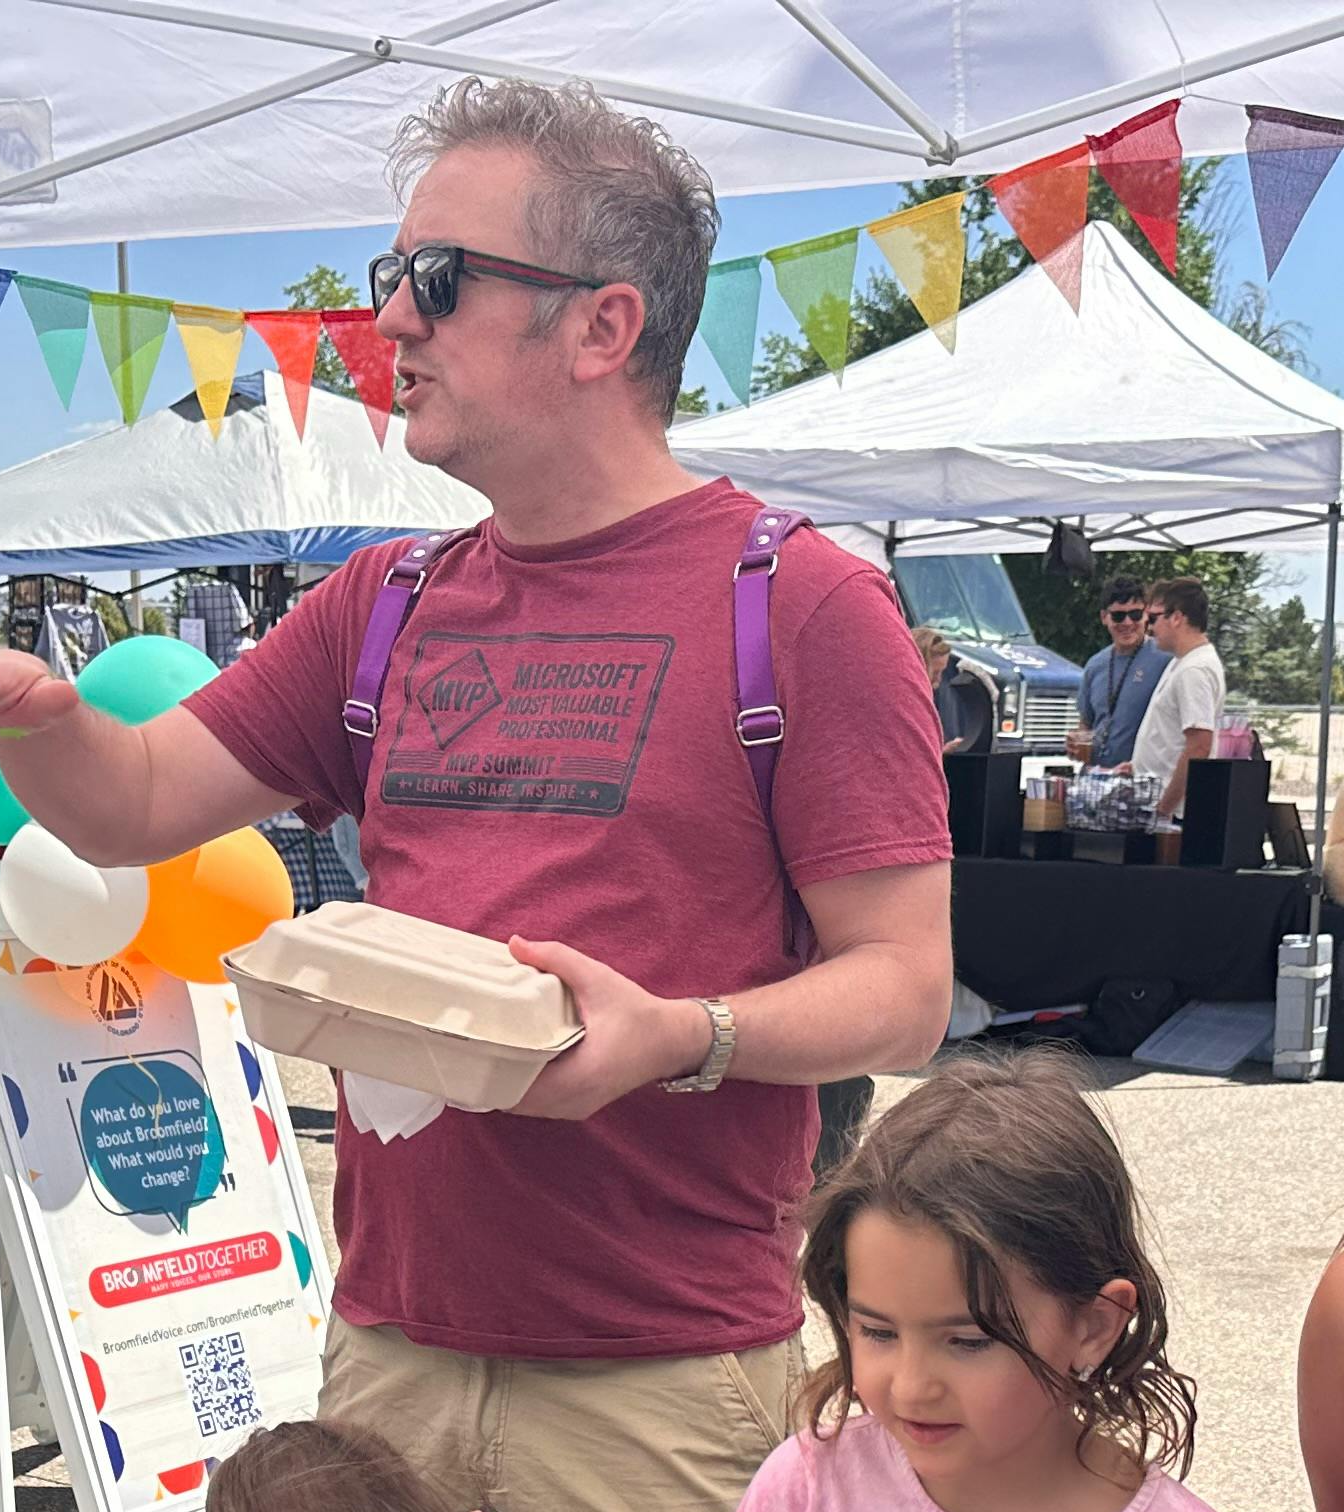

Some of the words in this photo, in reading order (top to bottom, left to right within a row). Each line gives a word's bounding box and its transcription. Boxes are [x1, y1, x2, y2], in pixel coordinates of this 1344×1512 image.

[512, 663, 647, 691] MICROSOFT
[431, 680, 489, 712] MVP
[506, 695, 548, 716] MOST
[550, 695, 634, 718] VALUABLE
[497, 719, 620, 745] PROFESSIONAL
[445, 754, 477, 774] MVP
[482, 755, 556, 777] SUMMIT
[91, 1106, 127, 1125] What
[129, 1102, 145, 1118] do
[148, 1102, 173, 1121] you
[174, 1096, 201, 1112] love
[96, 1129, 133, 1149] about
[135, 1117, 209, 1143] Broomfield?
[108, 1149, 143, 1170] What
[145, 1144, 184, 1164] would
[185, 1141, 210, 1161] you
[141, 1165, 191, 1189] change?
[103, 1297, 297, 1355] BroomfieldVoice.com/BroomfieldTogether
